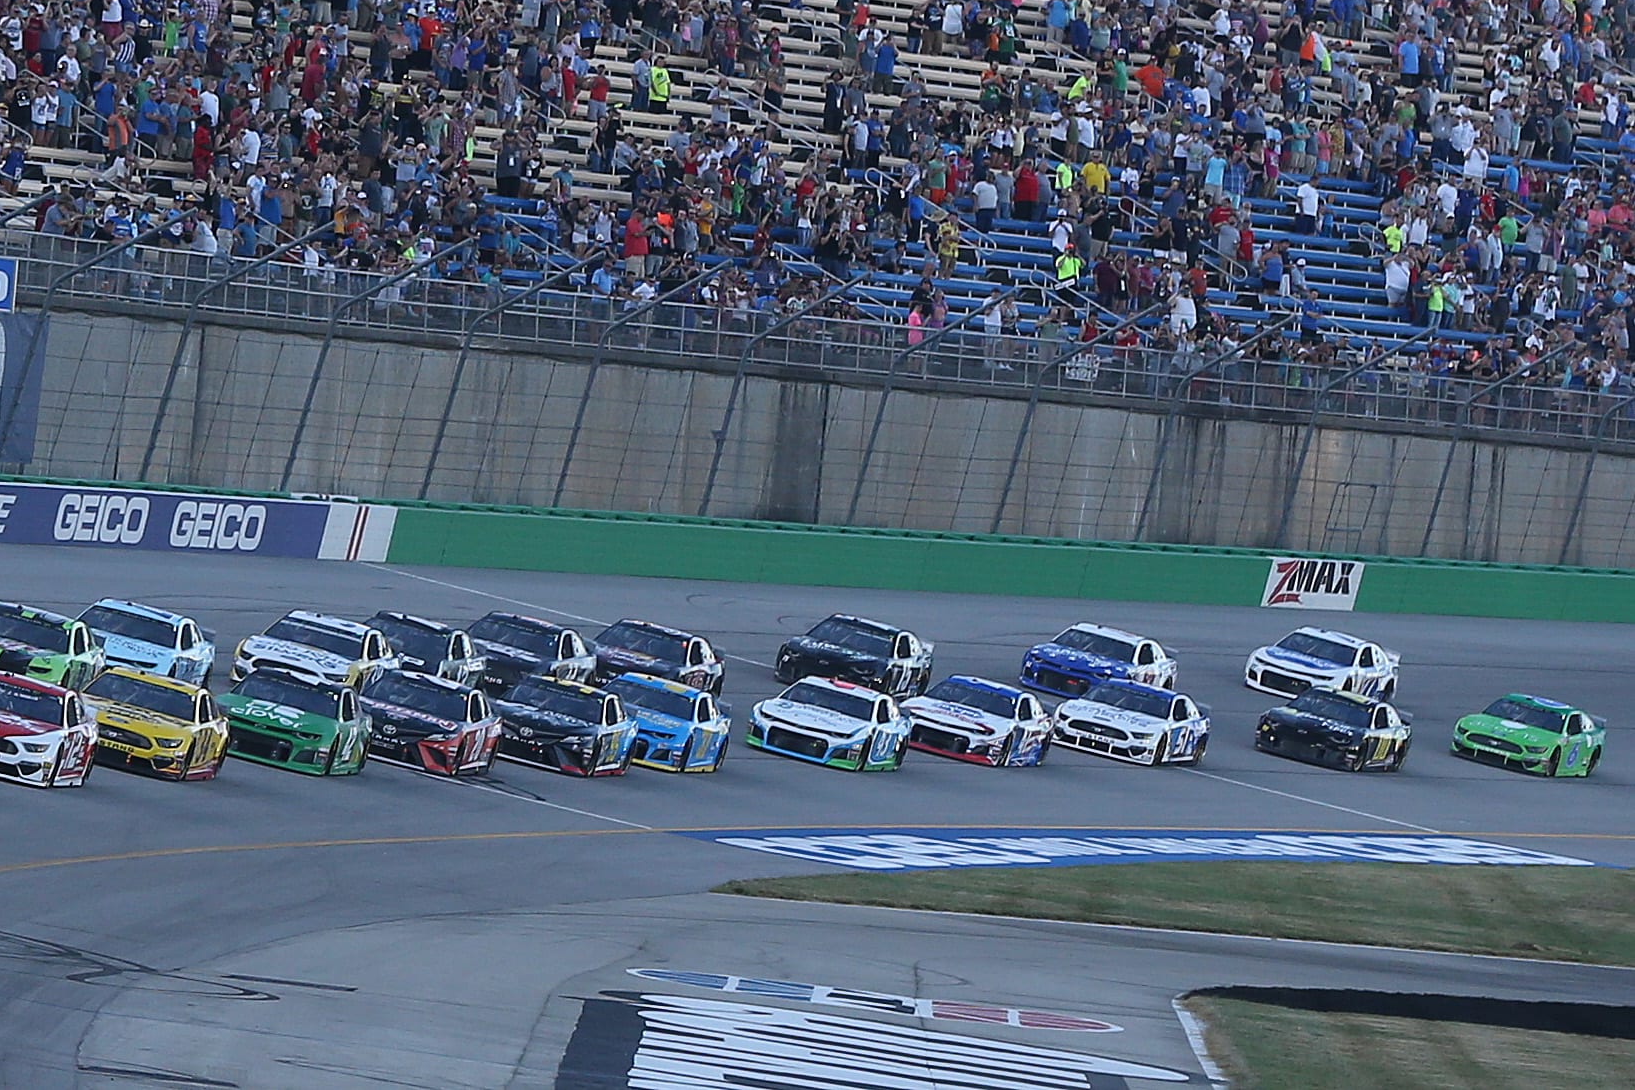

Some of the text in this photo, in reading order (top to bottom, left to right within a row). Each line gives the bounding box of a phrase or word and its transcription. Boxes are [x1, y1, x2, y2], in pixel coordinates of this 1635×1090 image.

[53, 494, 150, 544] GEICO
[169, 501, 267, 551] GEICO
[99, 739, 134, 753] STANG
